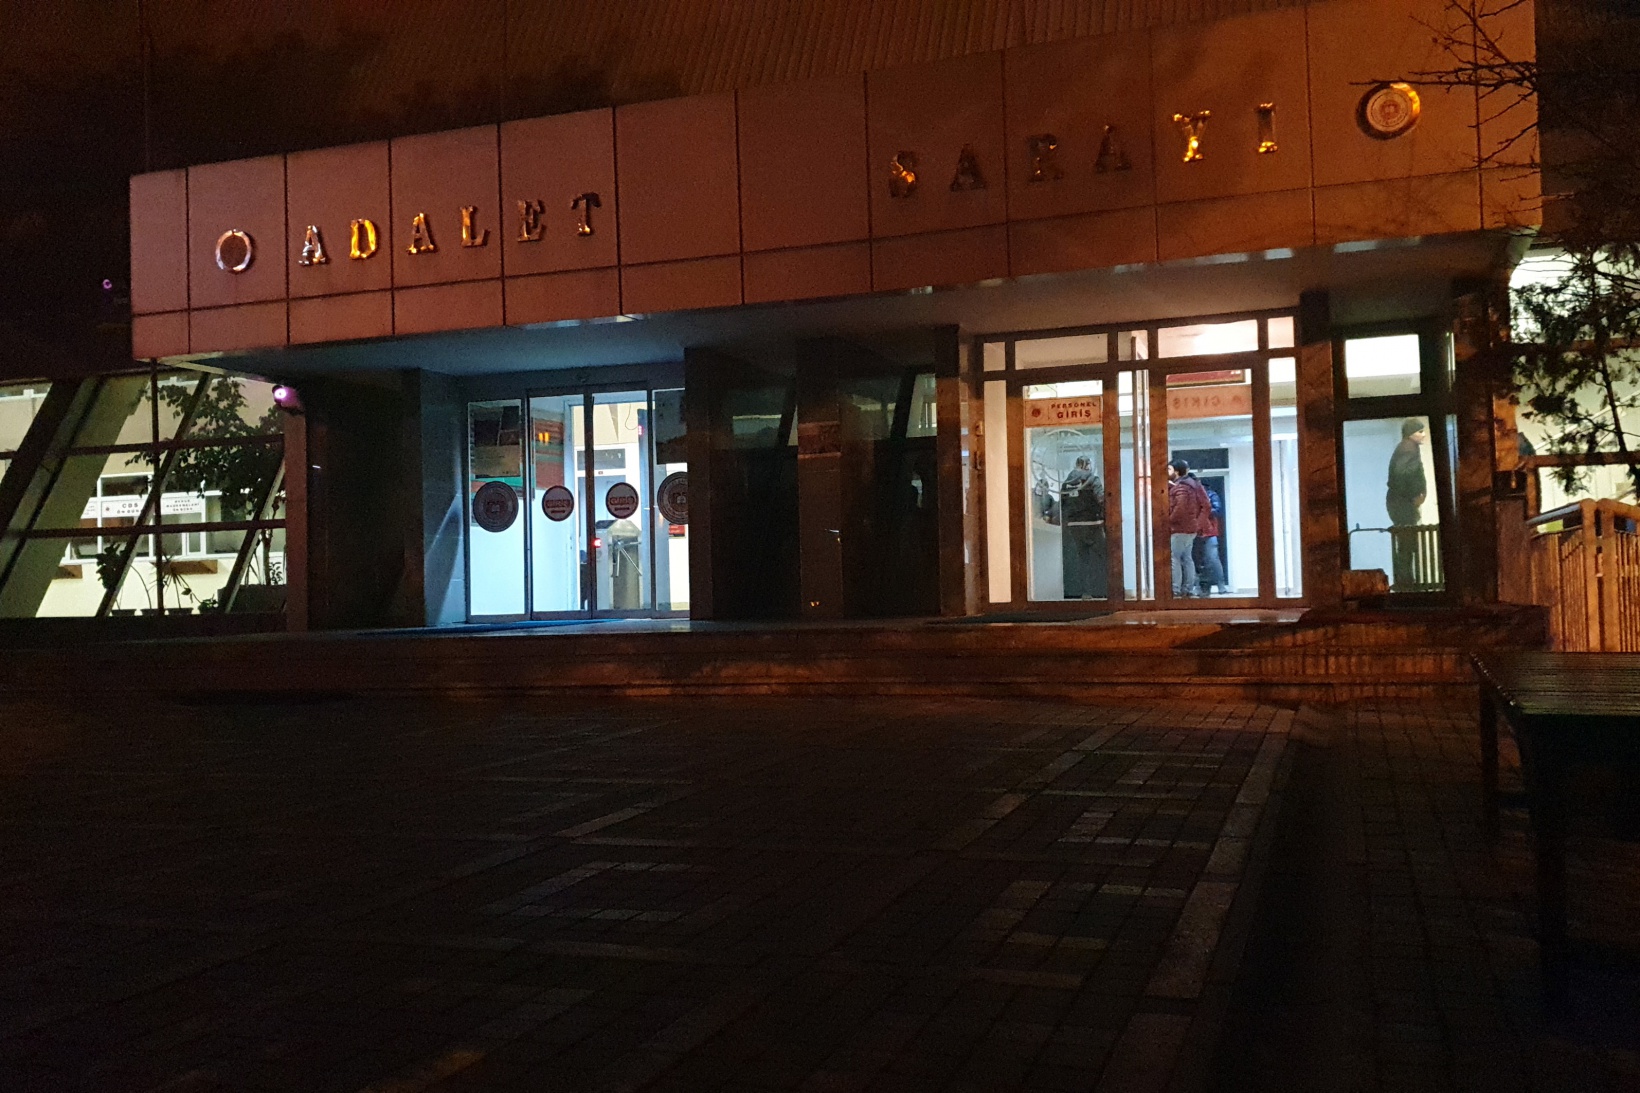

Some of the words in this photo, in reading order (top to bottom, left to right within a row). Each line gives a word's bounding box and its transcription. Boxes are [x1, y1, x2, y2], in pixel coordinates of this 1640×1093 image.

[298, 192, 602, 266] ADALET
[888, 101, 1277, 199] SARAYI
[1051, 401, 1097, 409] PERSONEL
